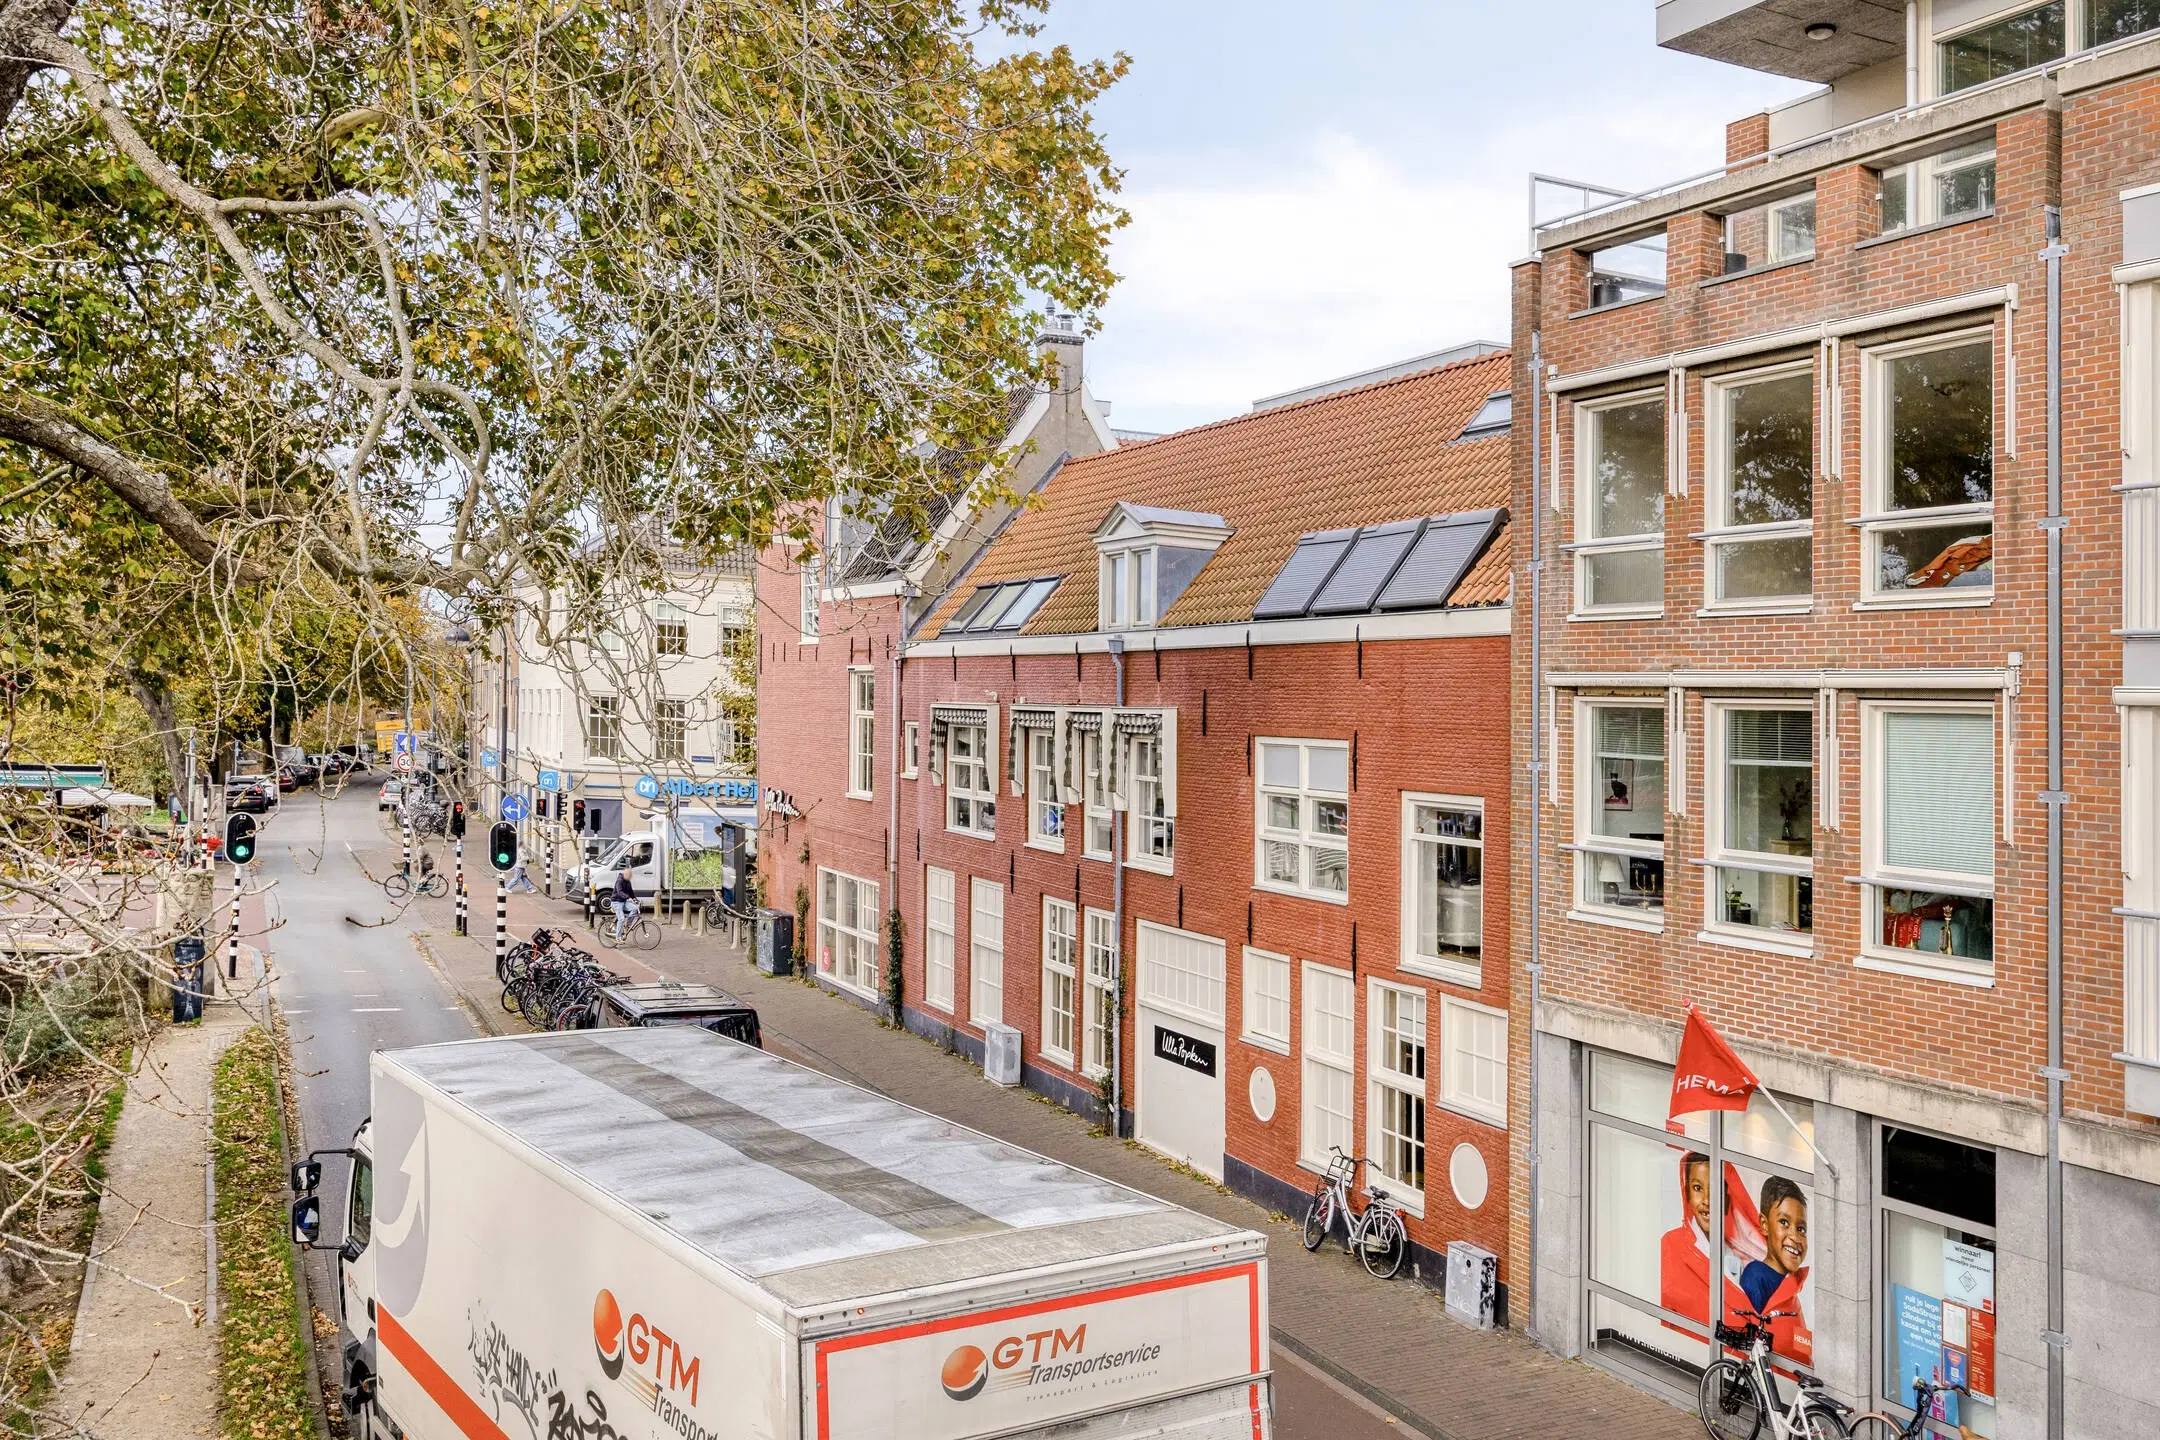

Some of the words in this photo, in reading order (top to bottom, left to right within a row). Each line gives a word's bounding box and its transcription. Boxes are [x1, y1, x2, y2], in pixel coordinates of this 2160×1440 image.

[400, 758, 411, 767] 30
[662, 777, 720, 798] Albert
[725, 779, 757, 802] Heij
[1163, 1031, 1178, 1056] Ulla
[1178, 1037, 1209, 1066] Popken
[993, 1323, 1087, 1369] GTM
[1794, 1334, 1812, 1347] HEMA
[627, 1312, 701, 1408] GTM
[1028, 1343, 1161, 1386] Transportservice
[1026, 1384, 1085, 1402] Transport
